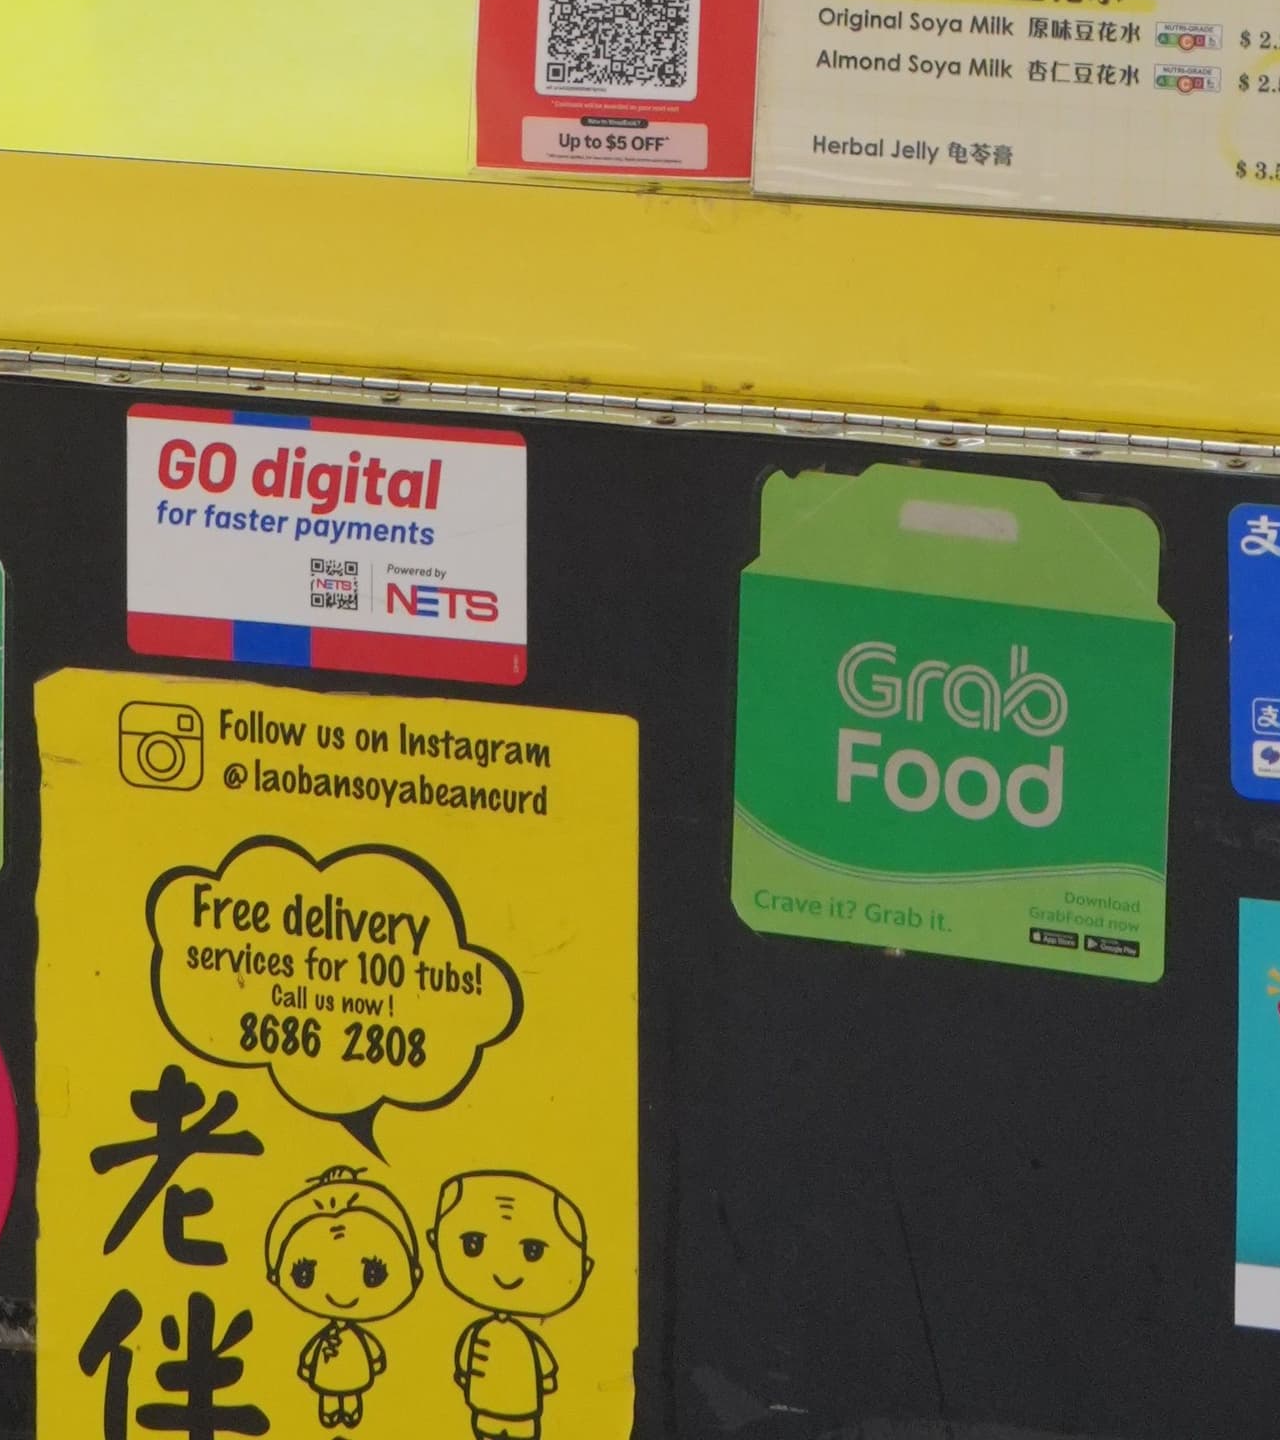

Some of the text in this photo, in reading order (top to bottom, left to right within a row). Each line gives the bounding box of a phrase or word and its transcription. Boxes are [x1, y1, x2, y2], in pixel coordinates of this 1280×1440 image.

[819, 8, 902, 31] Original
[910, 12, 962, 36] Soya
[970, 16, 1014, 36] Milk
[1028, 17, 1140, 43] 原味豆花水
[816, 50, 901, 71] Almond
[908, 55, 961, 78] Soya
[969, 58, 1012, 78] Milk
[1028, 60, 1140, 87] 杏仁豆花水
[559, 133, 581, 152] Up
[585, 136, 602, 150] to
[606, 134, 628, 151] $5
[813, 135, 884, 157] Herbal
[891, 140, 939, 165] Jelly
[948, 141, 1013, 167] 龟苓膏
[158, 438, 442, 515] GO digital
[156, 500, 435, 546] for faster payments
[386, 564, 447, 580] Powered by
[386, 582, 499, 623] NETS
[220, 709, 551, 769] Follow us on Instagram
[193, 883, 430, 955] Free delivery
[186, 942, 483, 996] services for 100 tubs!
[271, 984, 308, 1011] Call
[315, 991, 336, 1013] us
[239, 1012, 427, 1068] 8686 2808
[78, 1064, 271, 1440] 老伴
